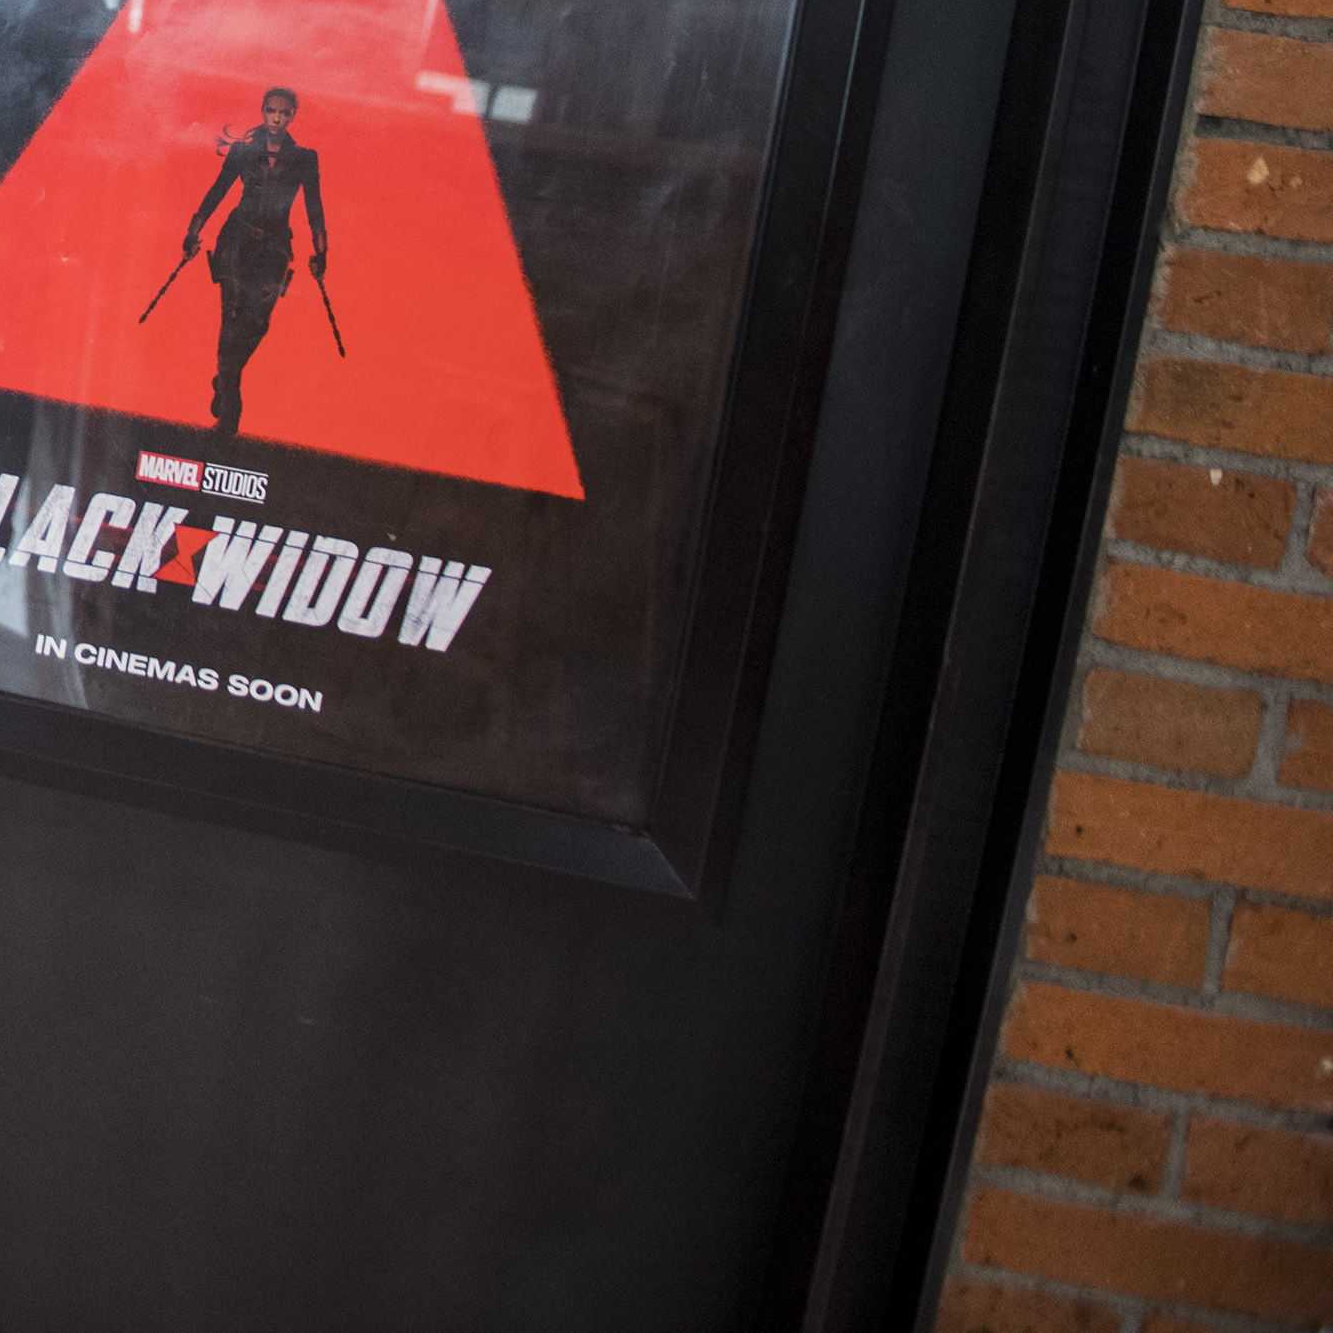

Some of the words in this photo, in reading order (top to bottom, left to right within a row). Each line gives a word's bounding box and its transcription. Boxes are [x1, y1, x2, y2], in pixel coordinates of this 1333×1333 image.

[137, 453, 200, 488] MARVEL
[201, 466, 269, 501] STUDIOS
[191, 515, 493, 653] WIDOW
[35, 633, 67, 660] IN
[74, 642, 220, 692] CINEMAS
[227, 673, 323, 713] SOON
